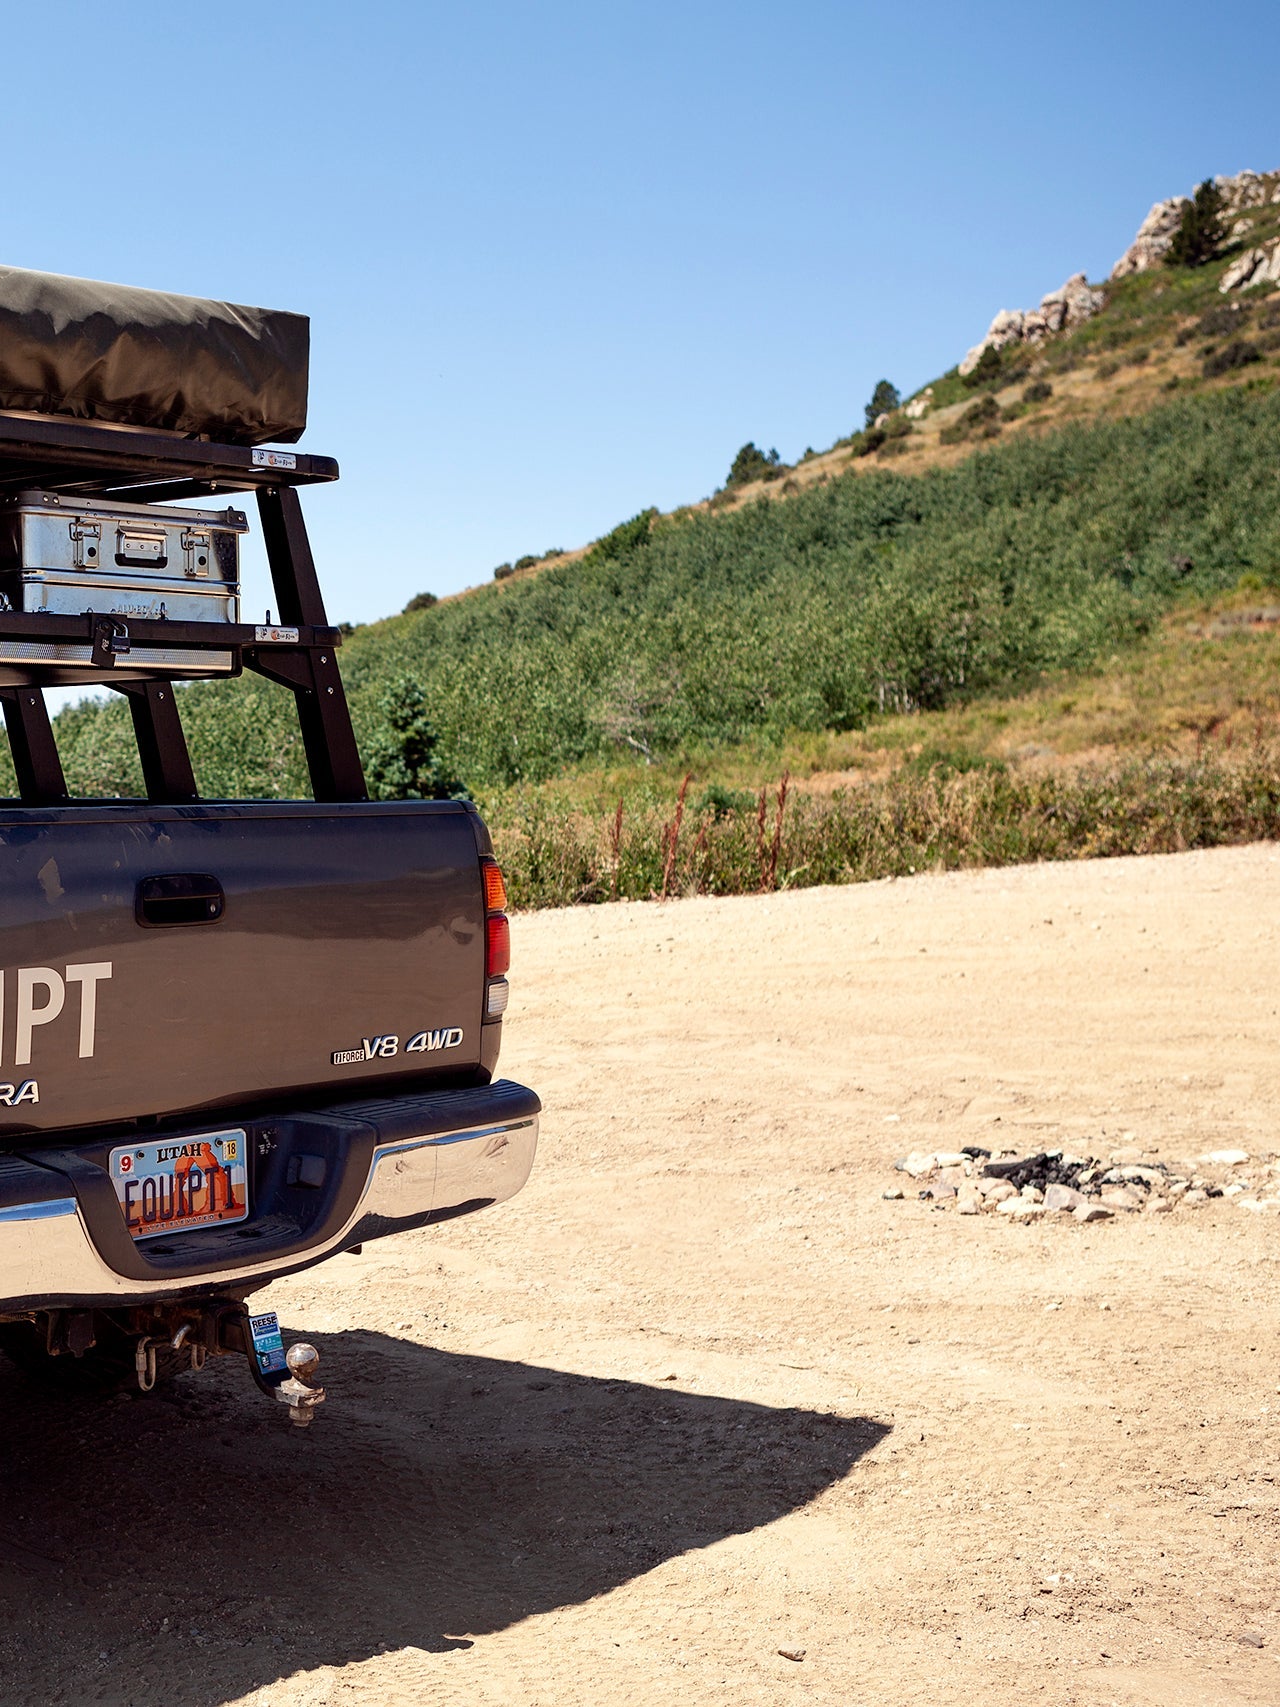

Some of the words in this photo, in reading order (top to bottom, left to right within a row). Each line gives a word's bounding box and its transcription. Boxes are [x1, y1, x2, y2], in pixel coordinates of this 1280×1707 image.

[363, 1034, 399, 1061] V8
[405, 1026, 464, 1052] 4WD
[157, 1142, 202, 1164] UTAH
[227, 1142, 236, 1155] 18
[120, 1155, 133, 1172] 9
[125, 1165, 234, 1227] EQUIPT1
[147, 1222, 167, 1232] LIFE
[169, 1214, 215, 1228] ELEVATED
[251, 1315, 278, 1329] REESE
